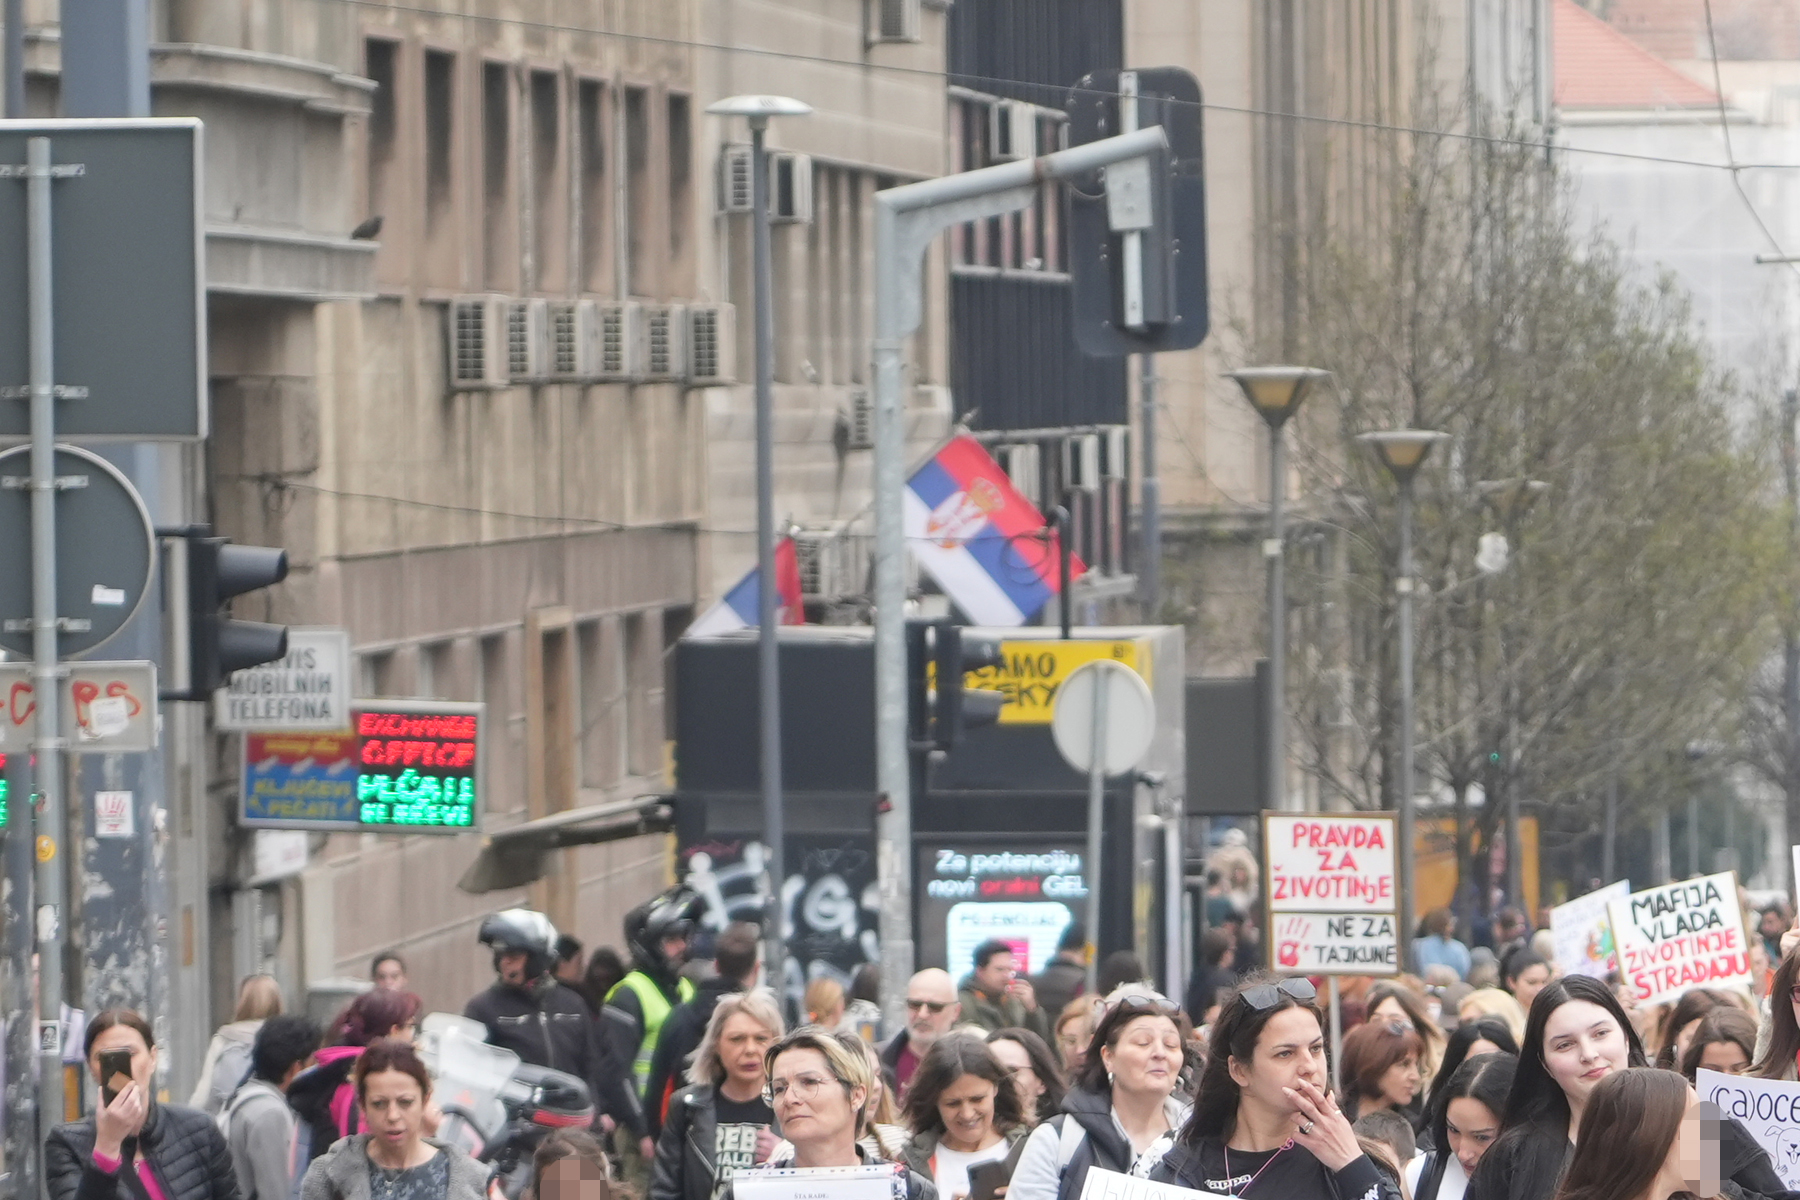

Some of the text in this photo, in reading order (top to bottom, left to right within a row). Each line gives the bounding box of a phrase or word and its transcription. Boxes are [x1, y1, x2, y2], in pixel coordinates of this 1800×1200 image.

[228, 698, 333, 720] TELEFONA
[361, 739, 476, 767] OFFICE
[1293, 823, 1385, 849] PRAVDA
[935, 850, 967, 874] Za
[1317, 850, 1358, 871] ZA
[927, 876, 976, 899] novi
[1042, 874, 1090, 899] GEL
[1631, 878, 1722, 926] MAFIJA
[1327, 917, 1394, 938] NE ZA
[1640, 907, 1723, 943] VLADA
[1314, 945, 1397, 964] TAJKUNE
[1625, 927, 1738, 974] ŽIVOTINJE
[1633, 951, 1751, 1000] STRADAJU
